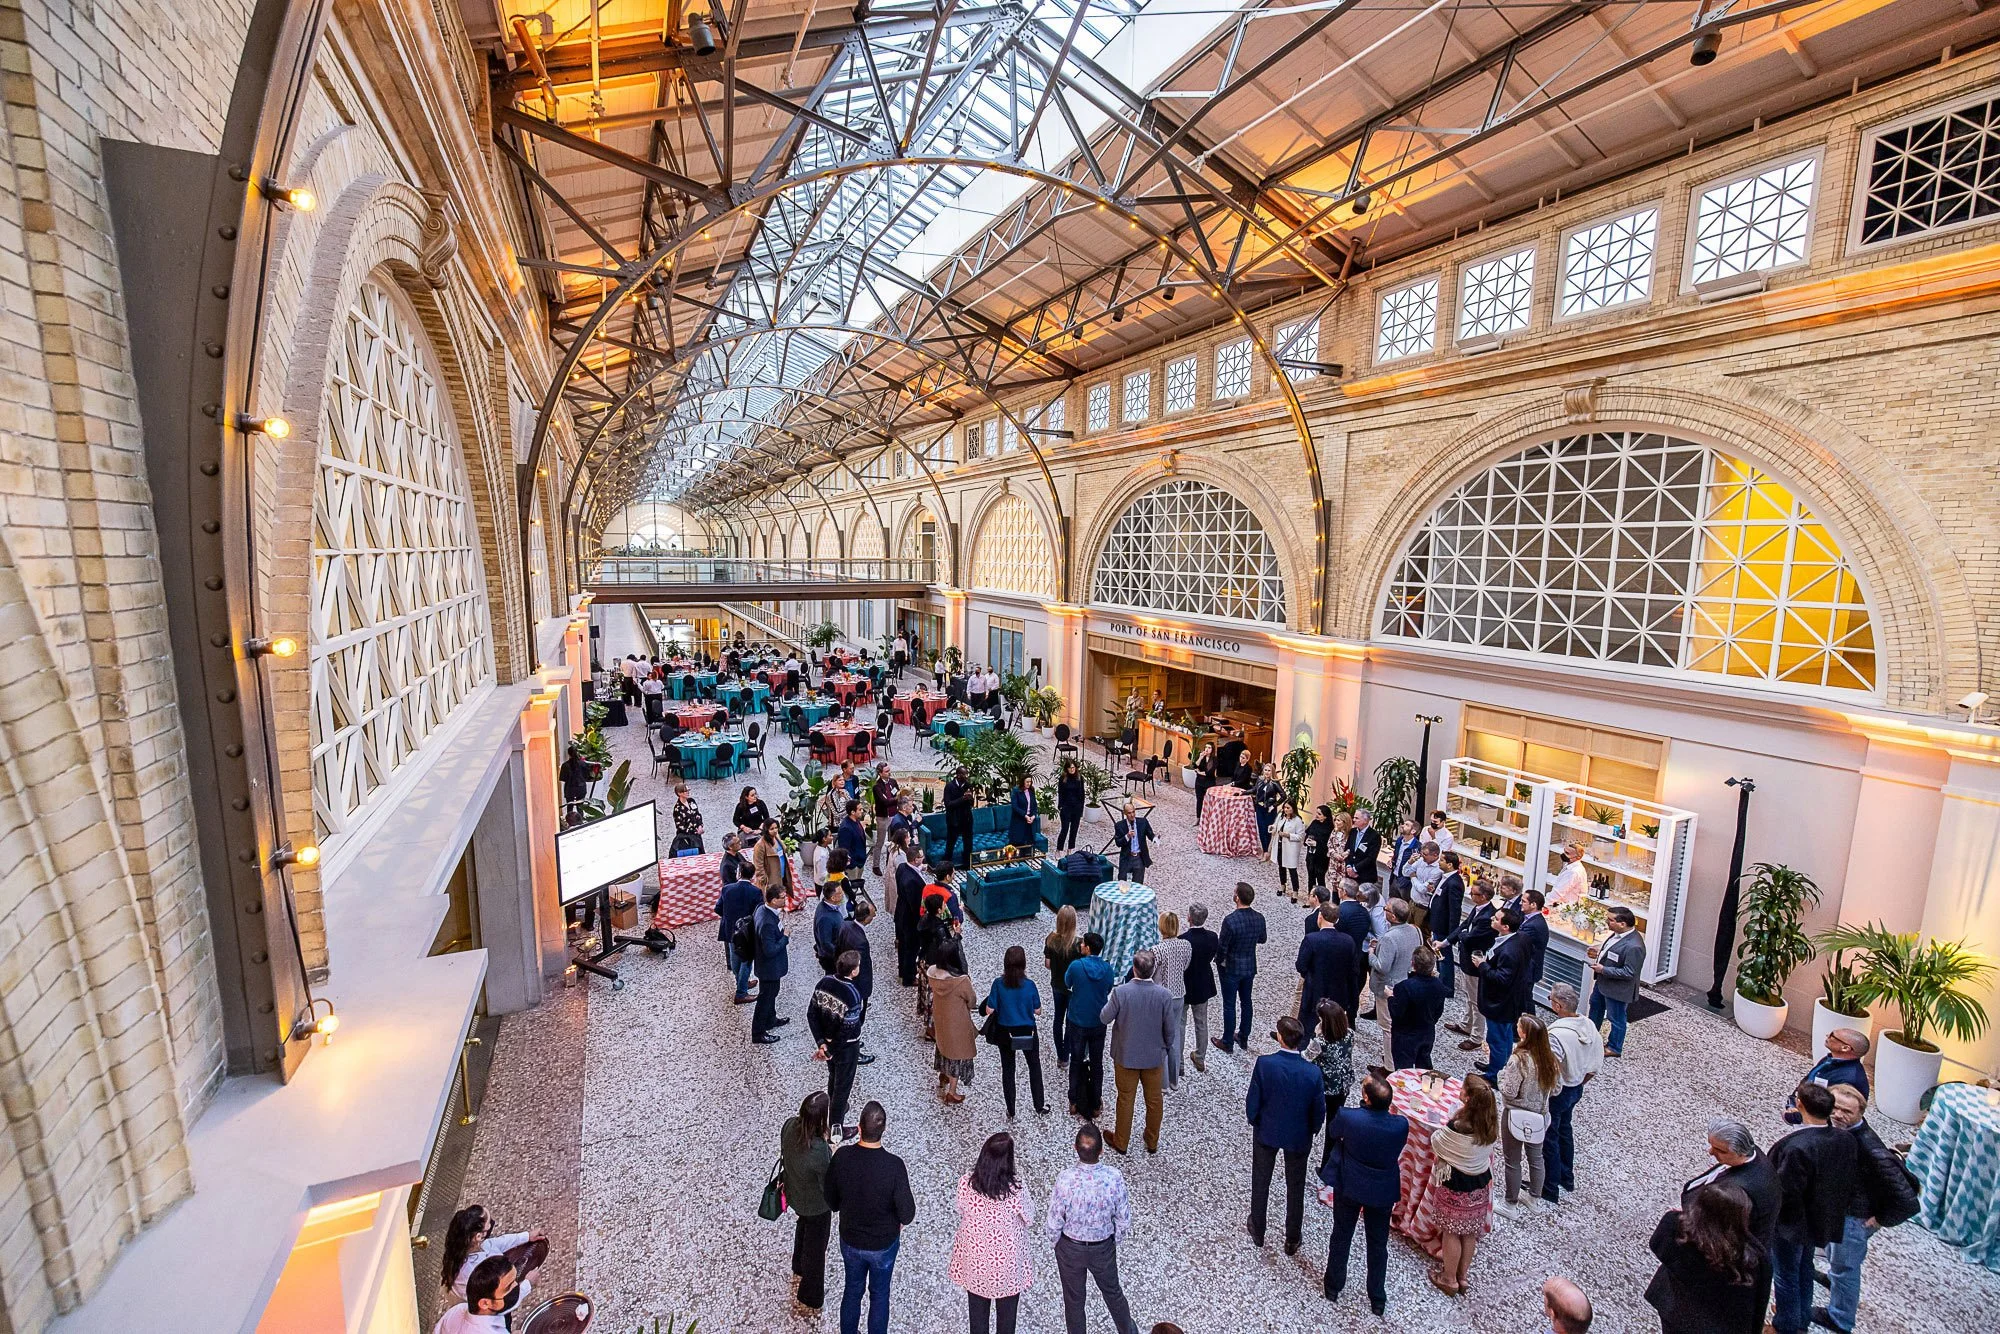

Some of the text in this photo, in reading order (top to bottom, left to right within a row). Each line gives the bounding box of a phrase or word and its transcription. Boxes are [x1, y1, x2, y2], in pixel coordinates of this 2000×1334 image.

[1110, 623, 1241, 653] PORT OF SAN FRANCISCO
